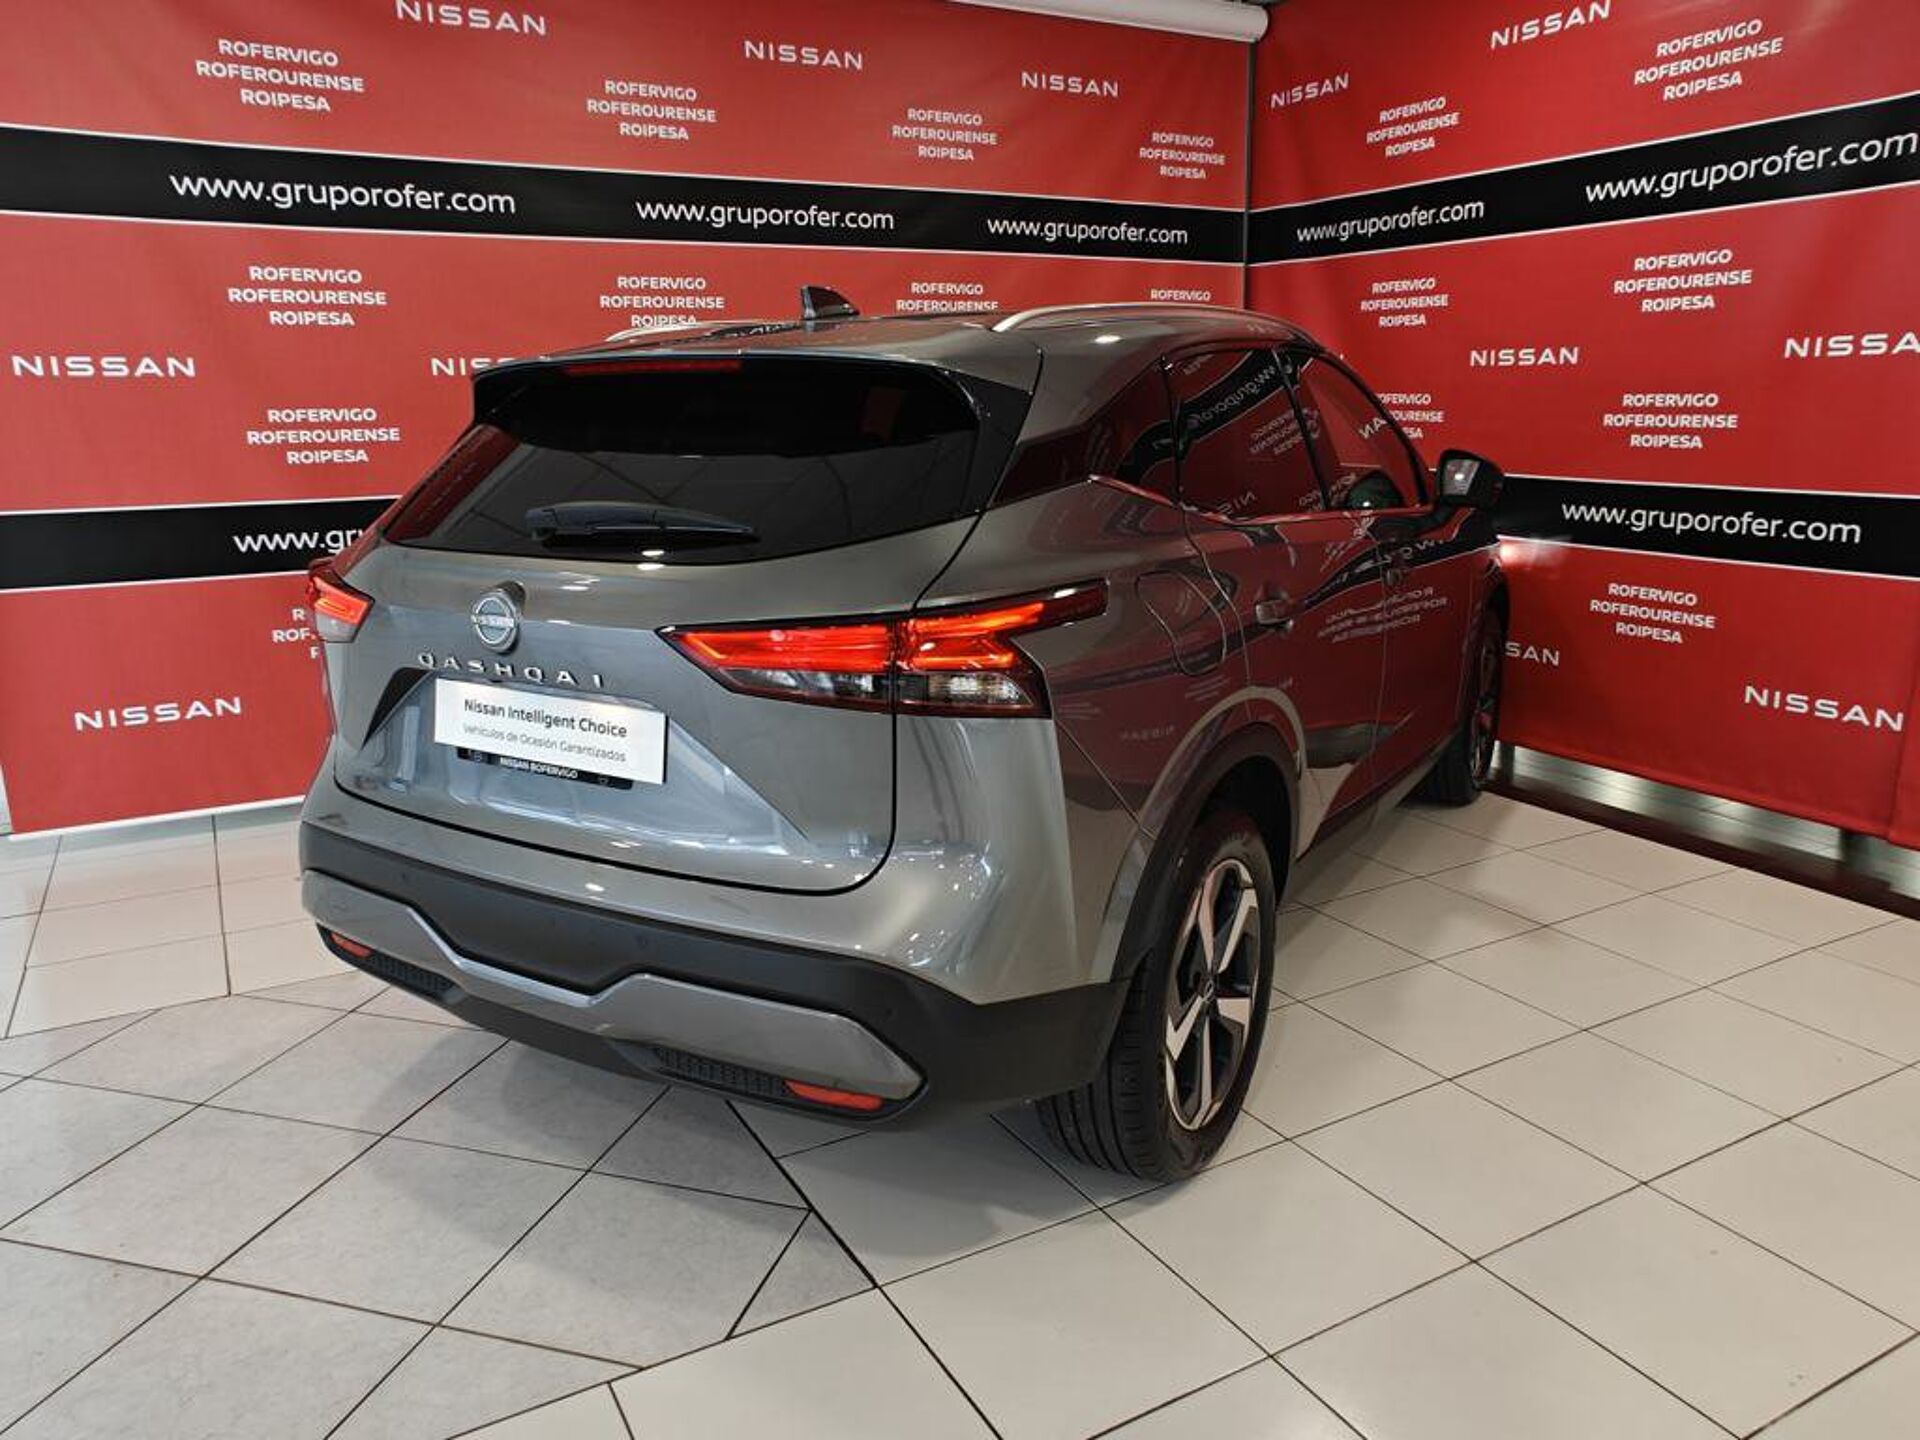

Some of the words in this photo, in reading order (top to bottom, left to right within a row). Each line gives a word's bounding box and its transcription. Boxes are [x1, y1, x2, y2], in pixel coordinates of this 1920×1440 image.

[395, 0, 546, 36] NISSAN
[1491, 0, 1610, 49] NISSAN
[1657, 19, 1762, 58] ROFERVIGO
[218, 39, 339, 67] ROFERVIGO
[745, 41, 862, 70] NISSAN
[1634, 37, 1784, 86] ROFEROURENSE
[195, 59, 364, 93] ROFEROURENSE
[1022, 72, 1117, 96] NISSAN
[1663, 71, 1743, 101] ROIPESA
[240, 88, 331, 112] ROIPESA
[605, 80, 697, 102] ROFERVIGO
[1270, 73, 1349, 109] NISSAN
[586, 98, 716, 123] ROFEROURENSE
[906, 108, 983, 128] ROFERVIGO
[1379, 97, 1447, 123] ROFERVIGO
[619, 122, 689, 140] ROIPESA
[893, 123, 996, 144] ROFEROURENSE
[1366, 111, 1460, 145] ROFEROURENSE
[1152, 132, 1214, 149] ROFERVIGO
[1384, 137, 1436, 158] ROIPESA
[918, 145, 974, 161] ROIPESA
[1139, 147, 1226, 167] ROFEROURENSE
[1160, 165, 1206, 180] ROIPESA
[1585, 132, 1919, 203] www.gruporofer.com
[170, 176, 515, 213] www.gruporofer.com
[636, 203, 893, 229] www.gruporofer.com
[1297, 200, 1485, 243] www.gruporofer.com
[988, 219, 1187, 243] www.gruporofer.com
[1635, 249, 1733, 273] ROFERVIGO
[249, 266, 362, 283] ROFERVIGO
[618, 277, 705, 289] ROFERVIGO
[1613, 268, 1753, 295] ROFEROURENSE
[228, 288, 386, 305] ROFEROURENSE
[911, 283, 983, 295] ROFERVIGO
[1151, 289, 1212, 302] ROFERVIGO
[1372, 278, 1436, 294] ROFERVIGO
[600, 296, 724, 308] ROFEROURENSE
[897, 300, 998, 312] ROFEROURENSE
[1361, 294, 1449, 311] ROFEROURENSE
[1642, 295, 1714, 312] ROIPESA
[270, 311, 354, 325] ROIPESA
[630, 314, 697, 328] ROIPESA
[1379, 314, 1426, 326] ROIPESA
[1783, 332, 1920, 359] NISSA
[12, 356, 195, 376] NISSAN
[429, 357, 515, 376] NIS
[1471, 347, 1578, 366] NISSAN
[1623, 394, 1718, 407] ROFERVIGO
[268, 408, 376, 422] ROFERVIGO
[1391, 409, 1446, 423] OURENSE
[1604, 414, 1737, 428] ROFEROURENSE
[247, 428, 399, 444] ROFEROURENSE
[1631, 435, 1702, 448] ROIPESA
[287, 450, 368, 464] ROIPESA
[1561, 503, 1861, 544] www.gruporofer.com
[1607, 583, 1698, 608] ROFERVIGO
[1590, 598, 1716, 631] ROFEROURENSE
[1615, 621, 1683, 645] ROIPESA
[1505, 641, 1560, 667] SAN
[418, 651, 605, 688] QASHQAI
[75, 697, 240, 730] NISSAN
[464, 699, 506, 718] Nissan
[508, 710, 576, 729] Intelligent
[579, 718, 628, 738] Choice
[1745, 686, 1903, 731] NISSAN
[560, 742, 627, 763] Garantizados
